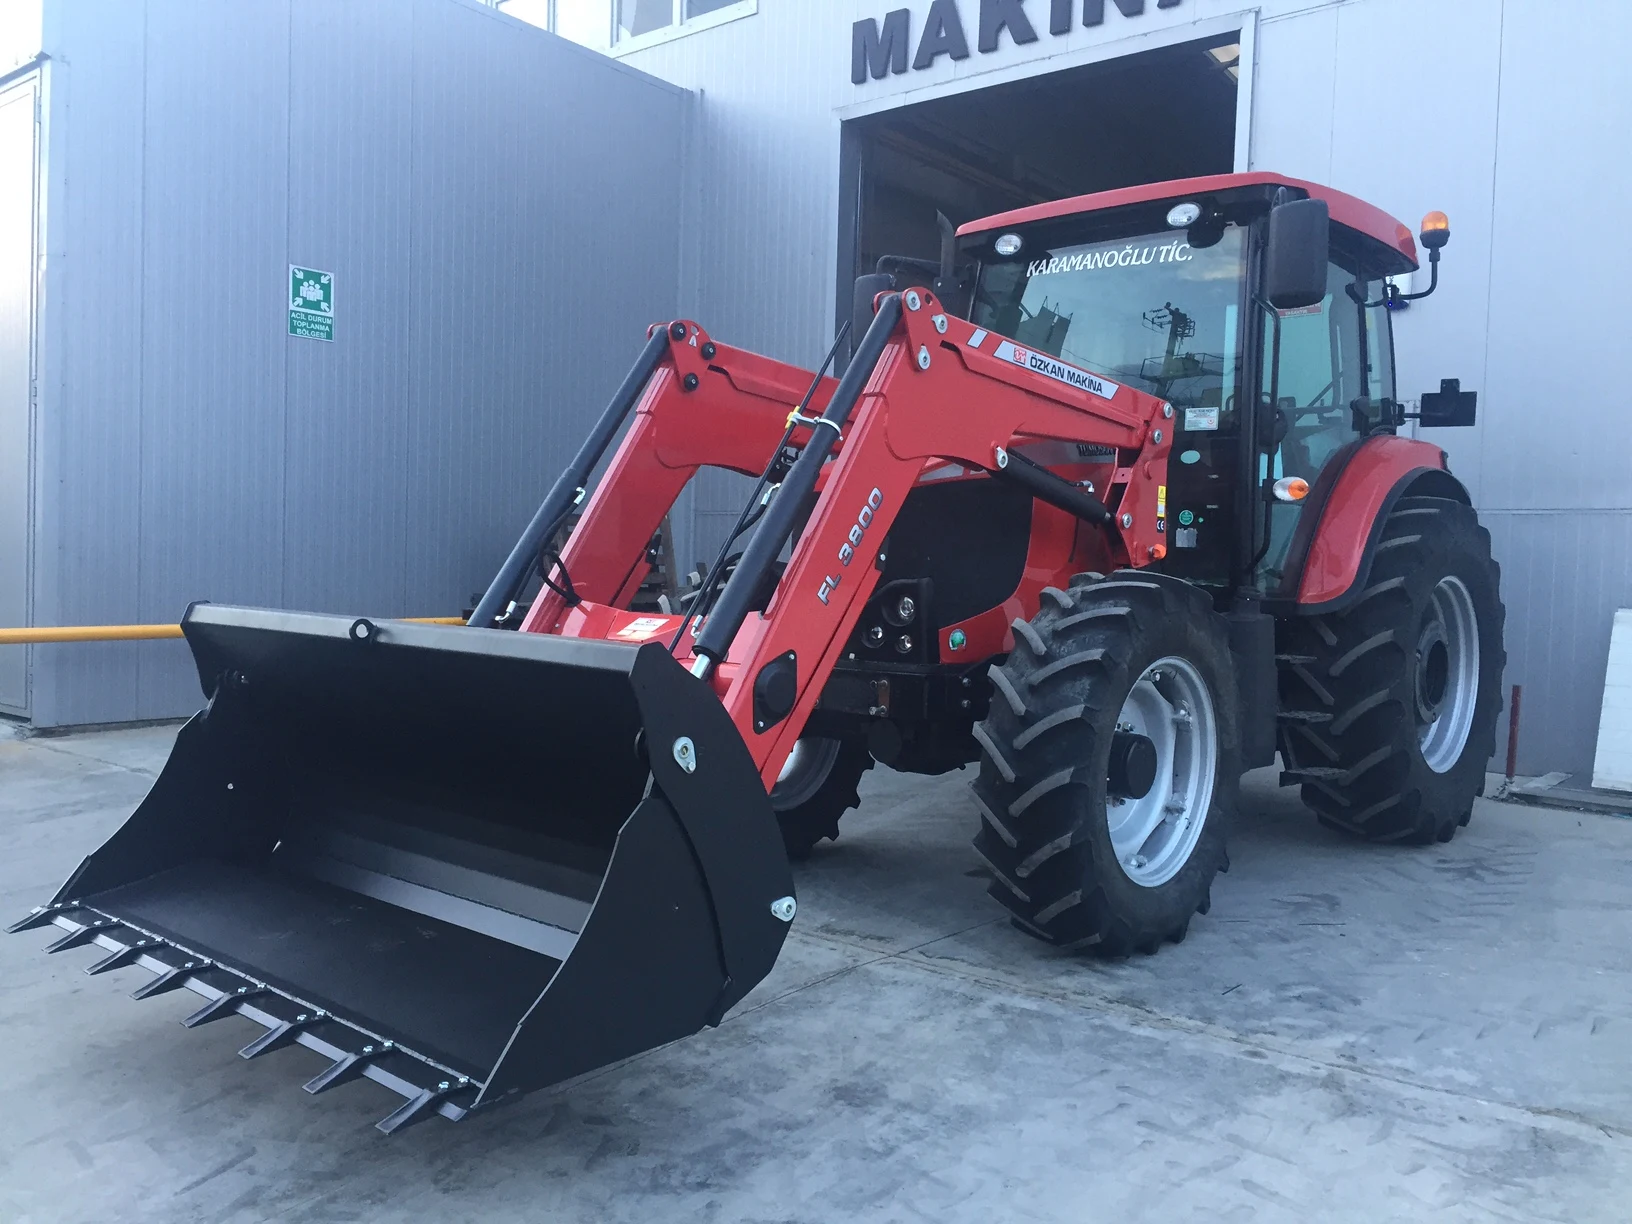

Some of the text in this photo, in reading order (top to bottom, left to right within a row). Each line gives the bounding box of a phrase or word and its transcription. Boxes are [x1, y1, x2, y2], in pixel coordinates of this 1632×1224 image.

[1026, 240, 1193, 277] KARAMANOĞLU TİC.
[291, 312, 332, 324] ACİL DURUM
[293, 320, 330, 332] TOPLANMA
[296, 328, 327, 338] BÖLGESİ
[1030, 354, 1064, 379] ÖZKAN
[1066, 369, 1103, 394] MAKİNA
[817, 487, 883, 606] FL 3800
